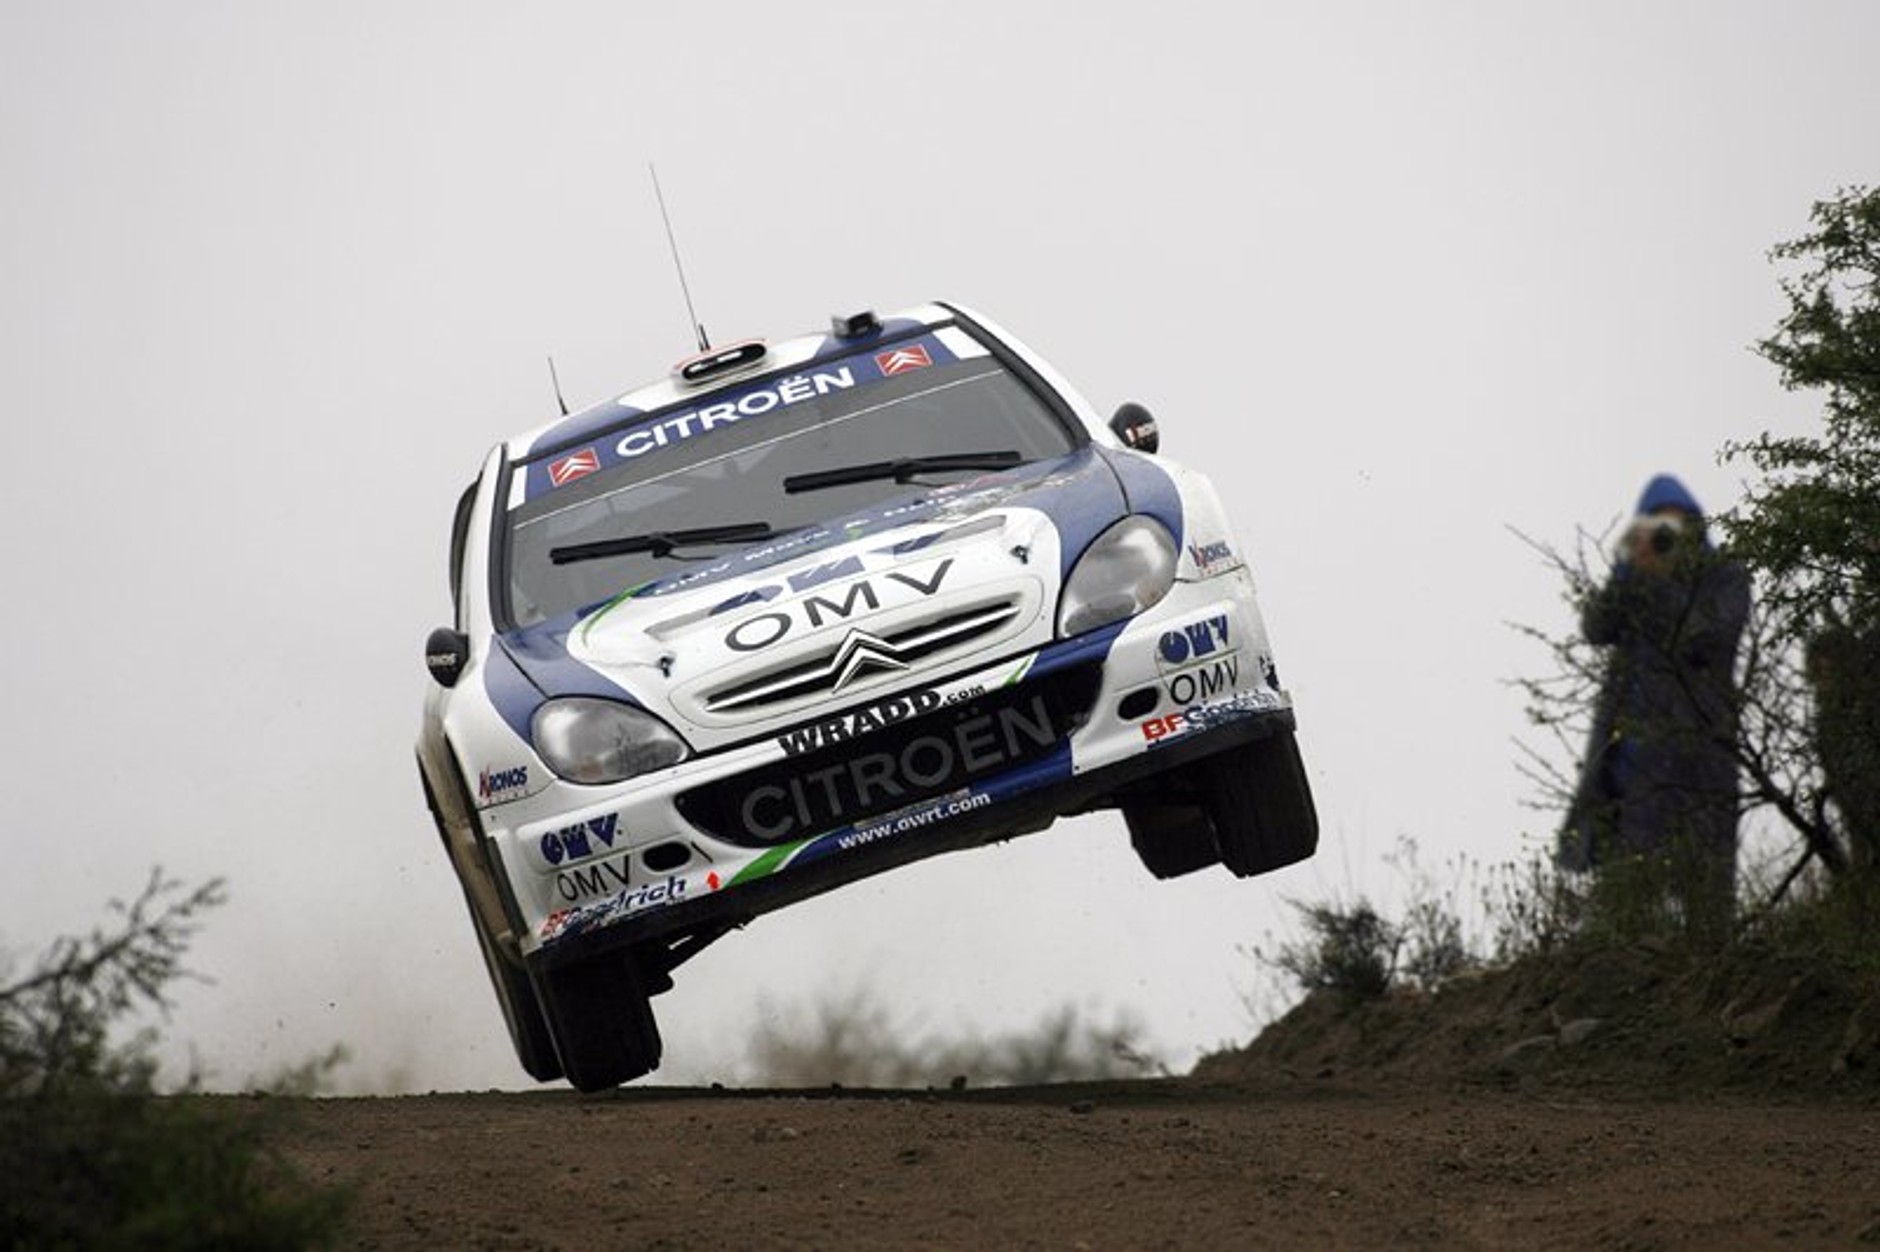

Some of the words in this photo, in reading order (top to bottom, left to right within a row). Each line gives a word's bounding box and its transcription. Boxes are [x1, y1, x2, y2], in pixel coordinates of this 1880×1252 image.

[616, 366, 855, 457] CITROËN
[724, 558, 955, 652] OMV
[1170, 656, 1238, 705] OMV
[479, 765, 527, 797] KRONOS
[741, 695, 1058, 840] CITROËN
[838, 791, 992, 851] www.owrt.com
[557, 854, 630, 902] OMV
